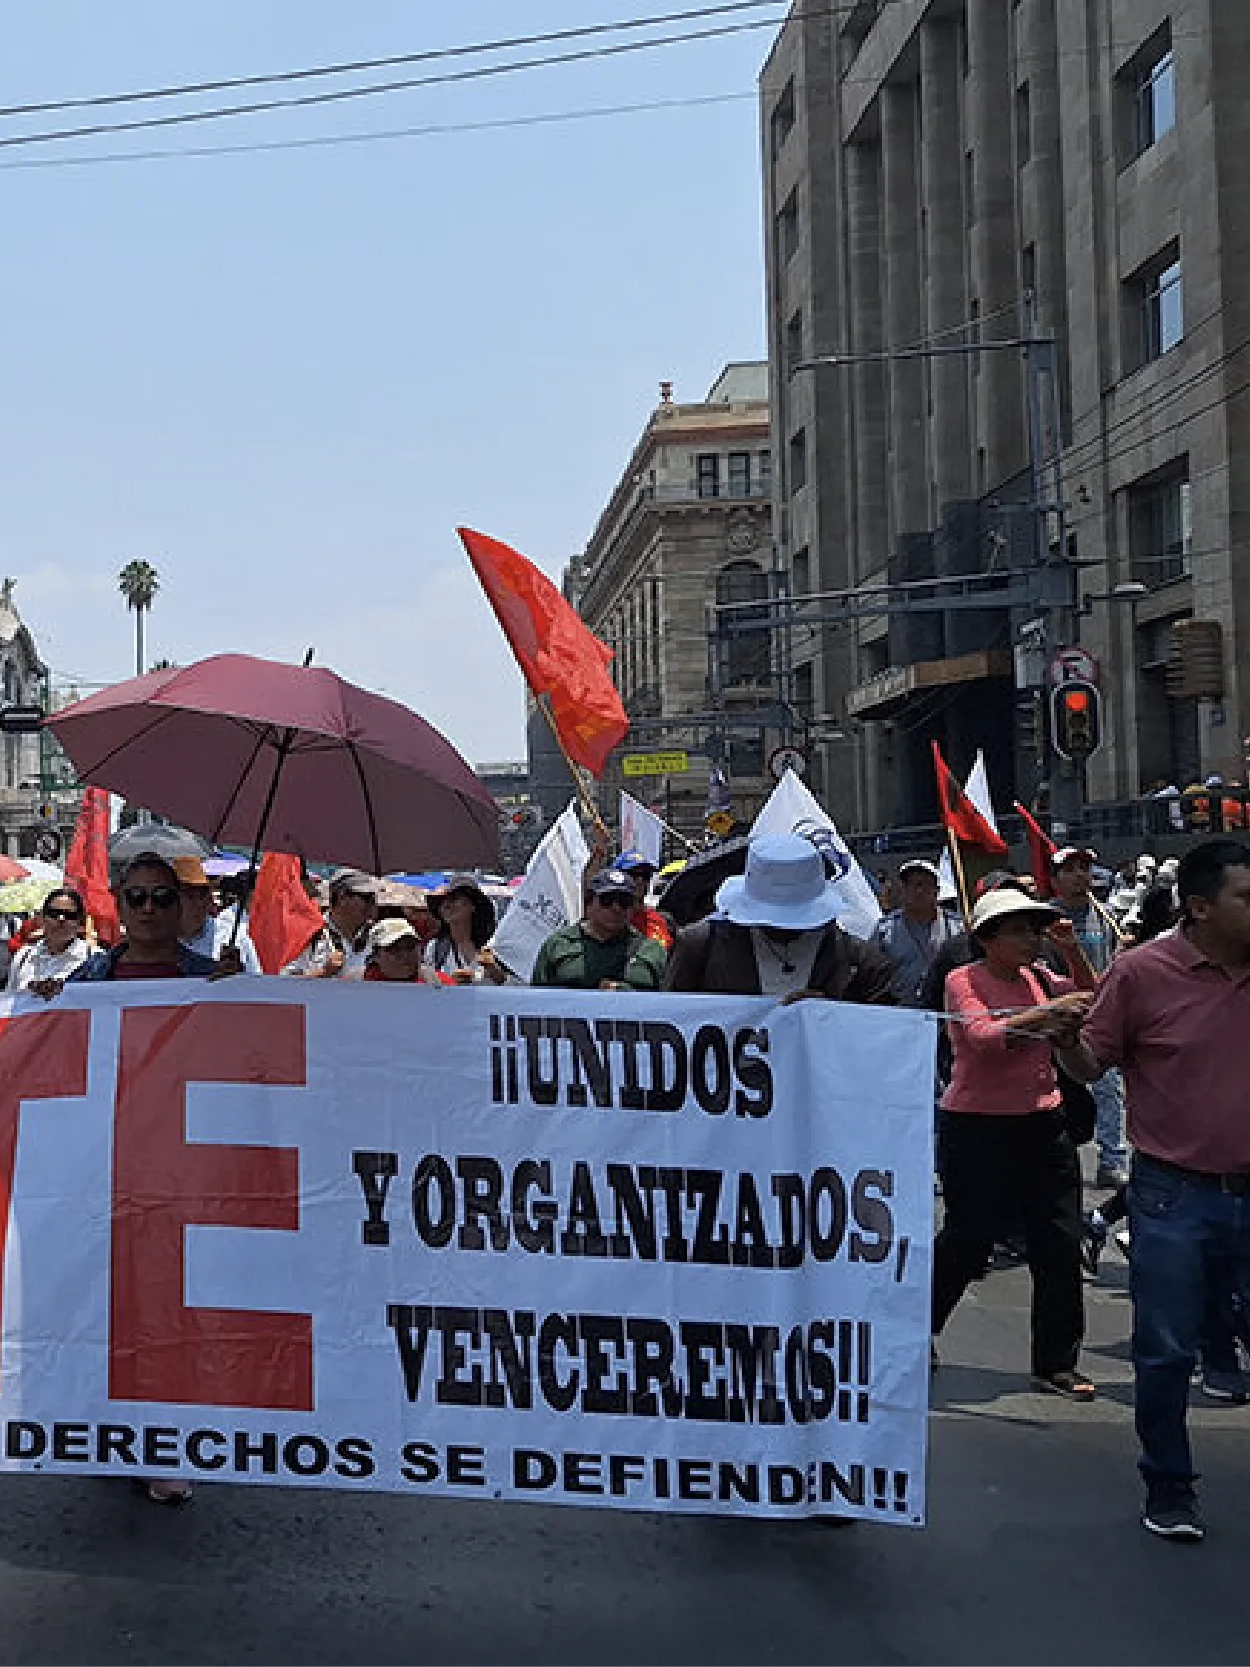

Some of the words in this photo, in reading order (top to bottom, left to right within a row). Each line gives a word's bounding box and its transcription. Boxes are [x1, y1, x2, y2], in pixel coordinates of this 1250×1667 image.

[489, 1014, 774, 1118] ¡¡UNIDOS
[352, 1151, 398, 1246] Y
[412, 1153, 908, 1282] ORGANIZADOS,
[386, 1304, 871, 1424] VENCEREMOS!!
[4, 1421, 376, 1479] DERECHOS
[400, 1441, 485, 1486] SE
